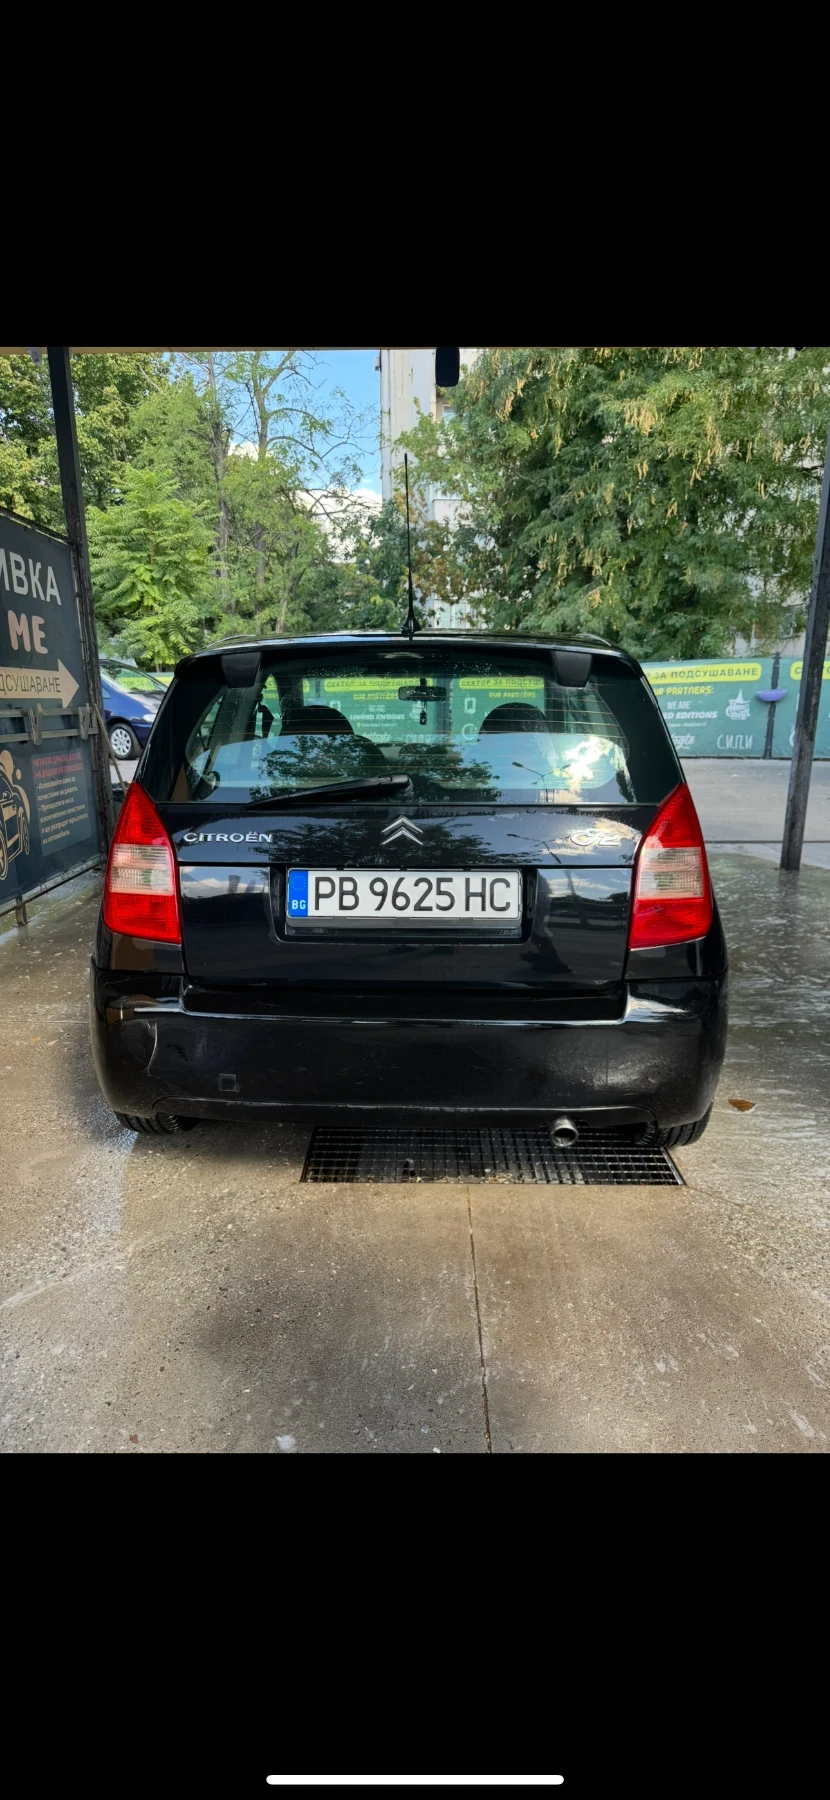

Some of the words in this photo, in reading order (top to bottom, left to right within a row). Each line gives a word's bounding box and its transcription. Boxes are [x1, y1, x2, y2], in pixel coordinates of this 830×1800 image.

[670, 667, 759, 679] ПОДСУШАВАНЕ
[675, 711, 718, 720] EDITIONS
[183, 831, 273, 843] CITROËN
[314, 876, 360, 911] PB
[370, 876, 456, 912] 9625
[464, 876, 511, 912] HC
[291, 899, 307, 910] BG
